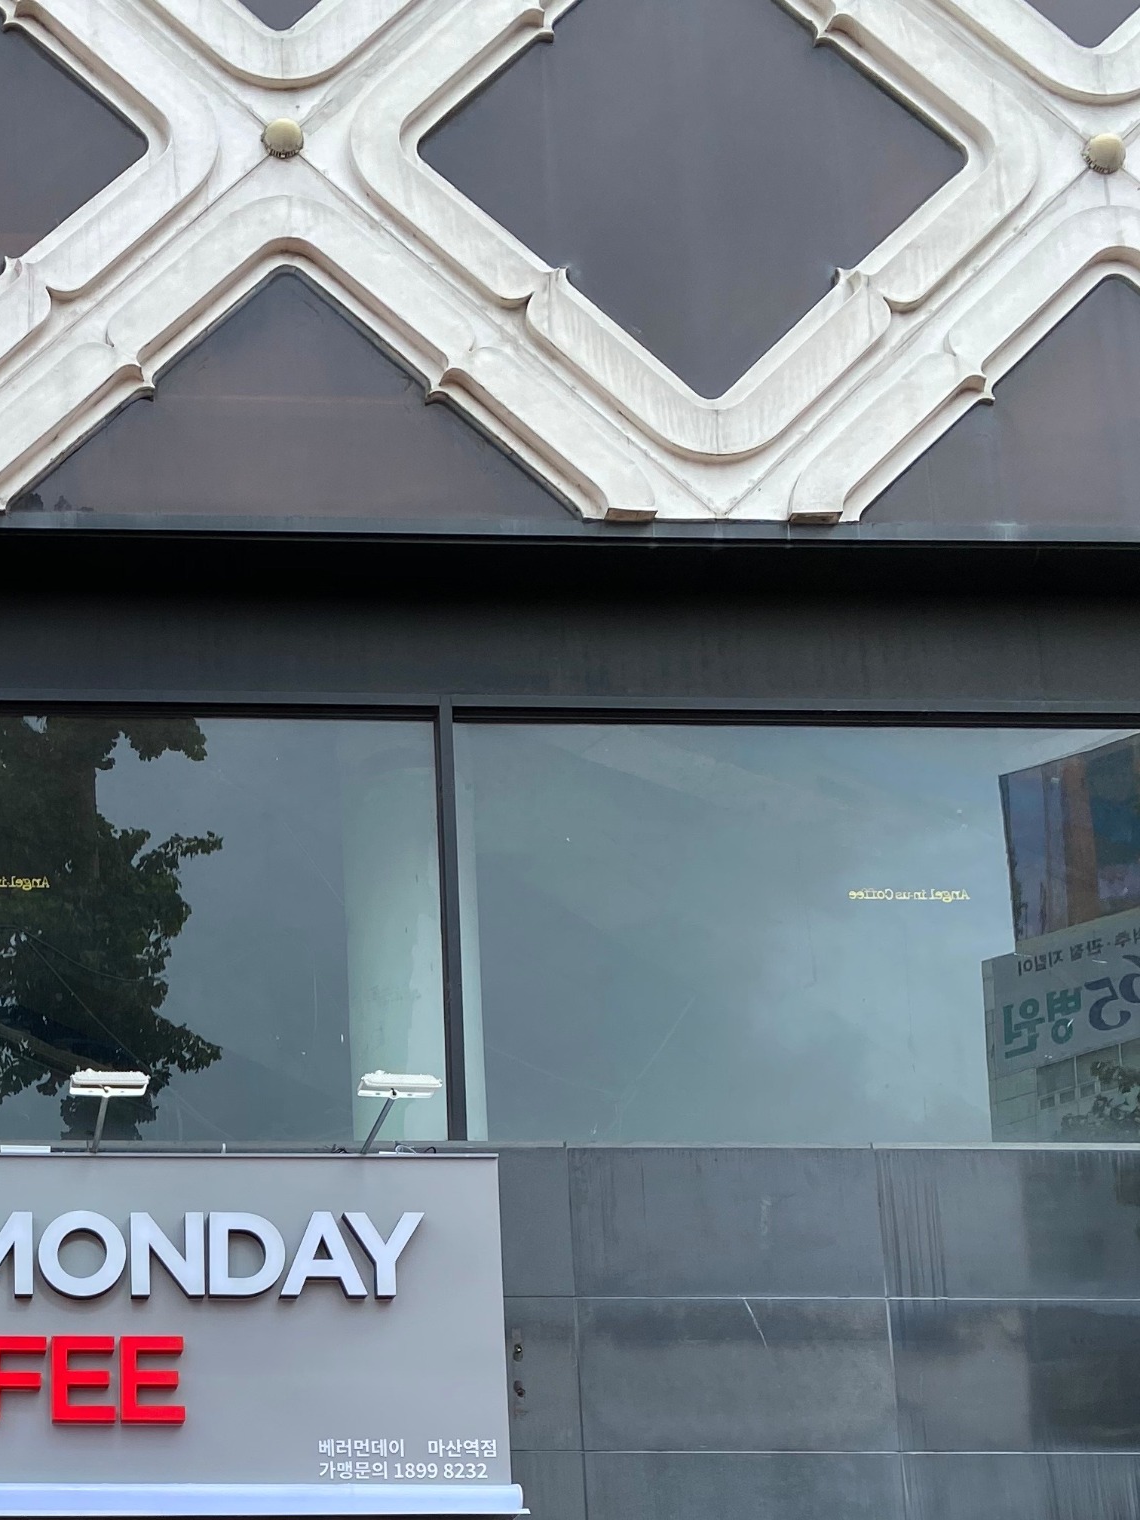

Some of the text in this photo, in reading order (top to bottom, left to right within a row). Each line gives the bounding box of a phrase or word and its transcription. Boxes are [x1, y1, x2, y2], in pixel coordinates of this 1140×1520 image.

[318, 1439, 497, 1457] 베러먼데이 마산역점
[318, 1461, 488, 1479] 가맹문의 1899 8232
